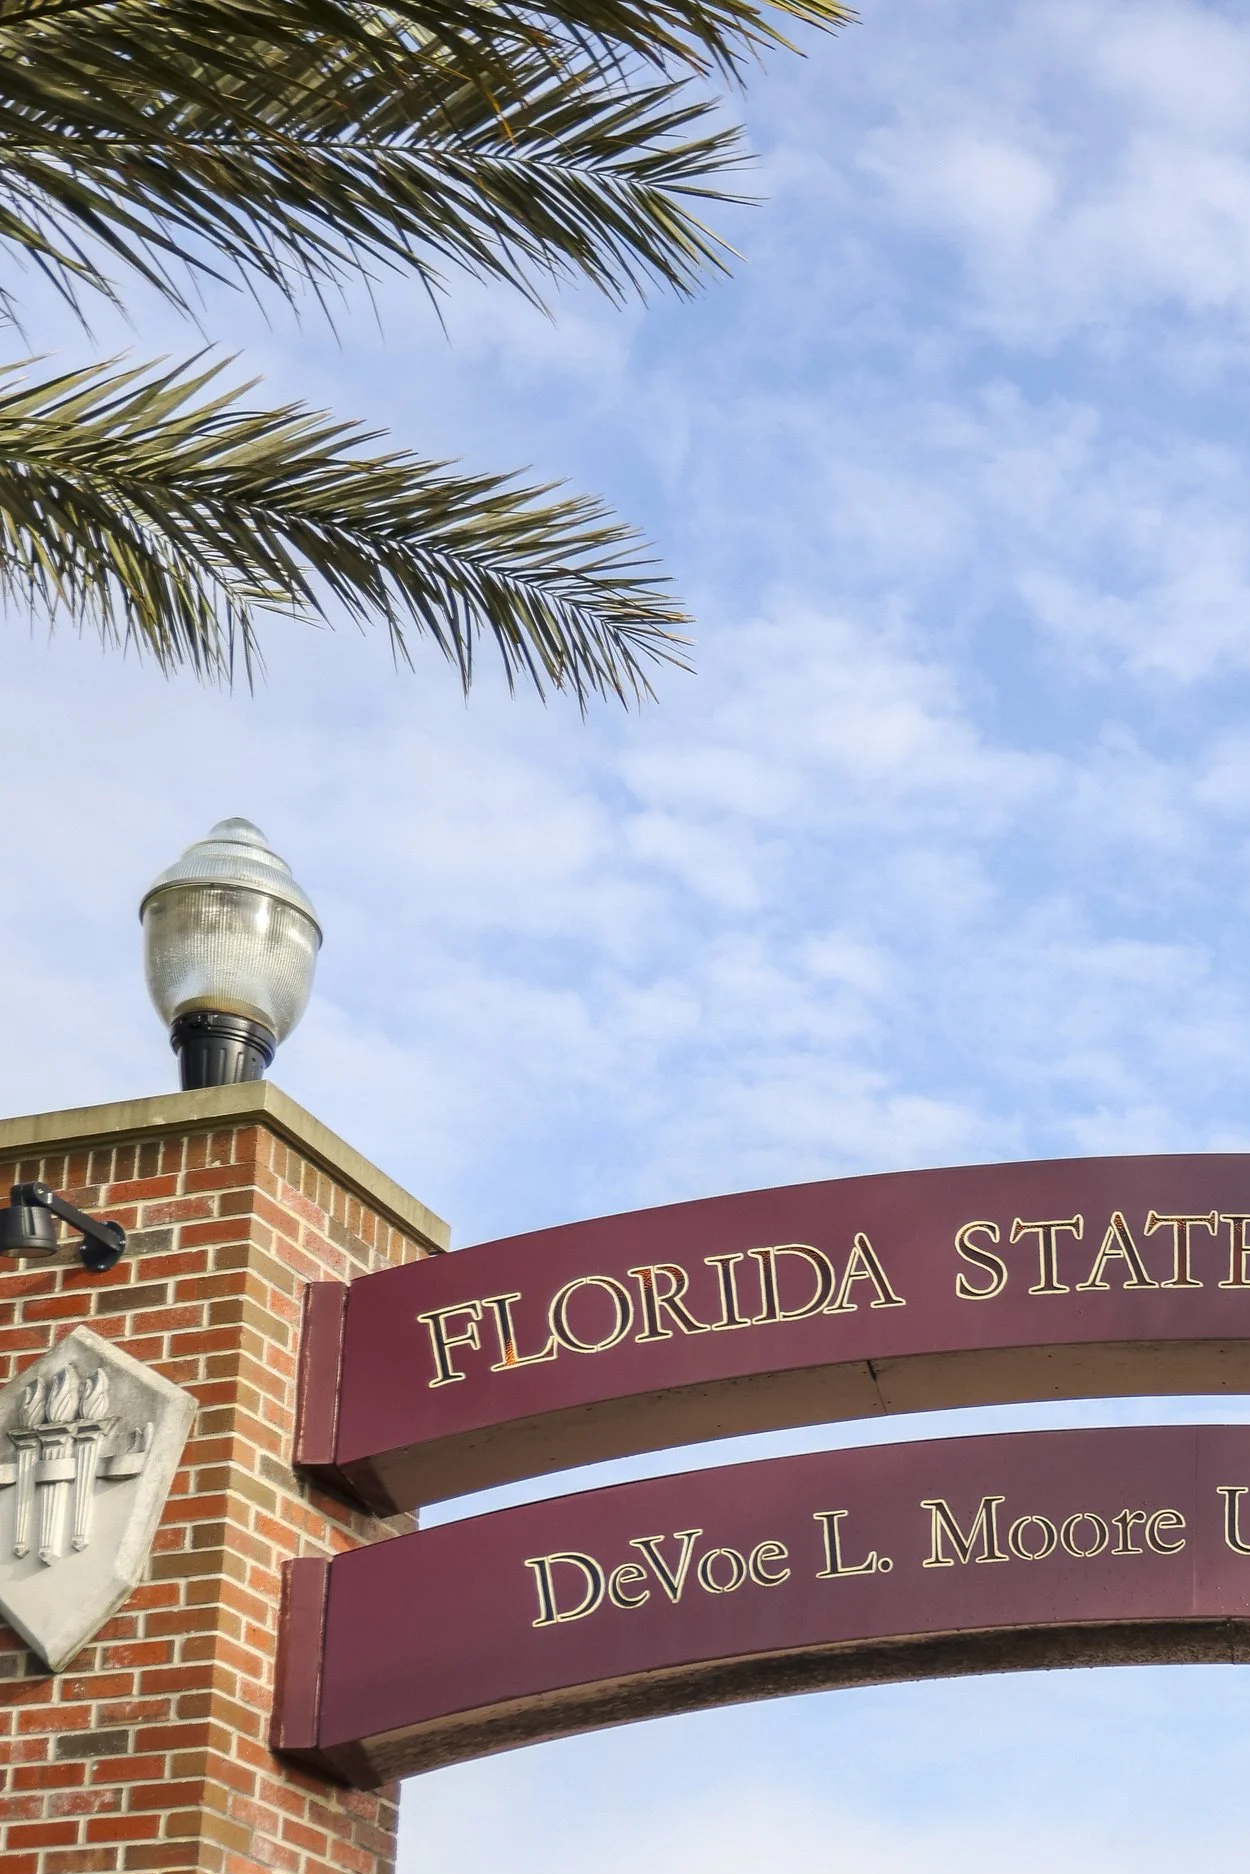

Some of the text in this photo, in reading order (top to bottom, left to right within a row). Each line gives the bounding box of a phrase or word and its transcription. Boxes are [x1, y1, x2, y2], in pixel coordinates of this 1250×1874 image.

[418, 1232, 906, 1388] FLORIDA
[524, 1528, 791, 1628] DeVoe
[813, 1509, 893, 1579] L.
[921, 1494, 1187, 1568] Moore
